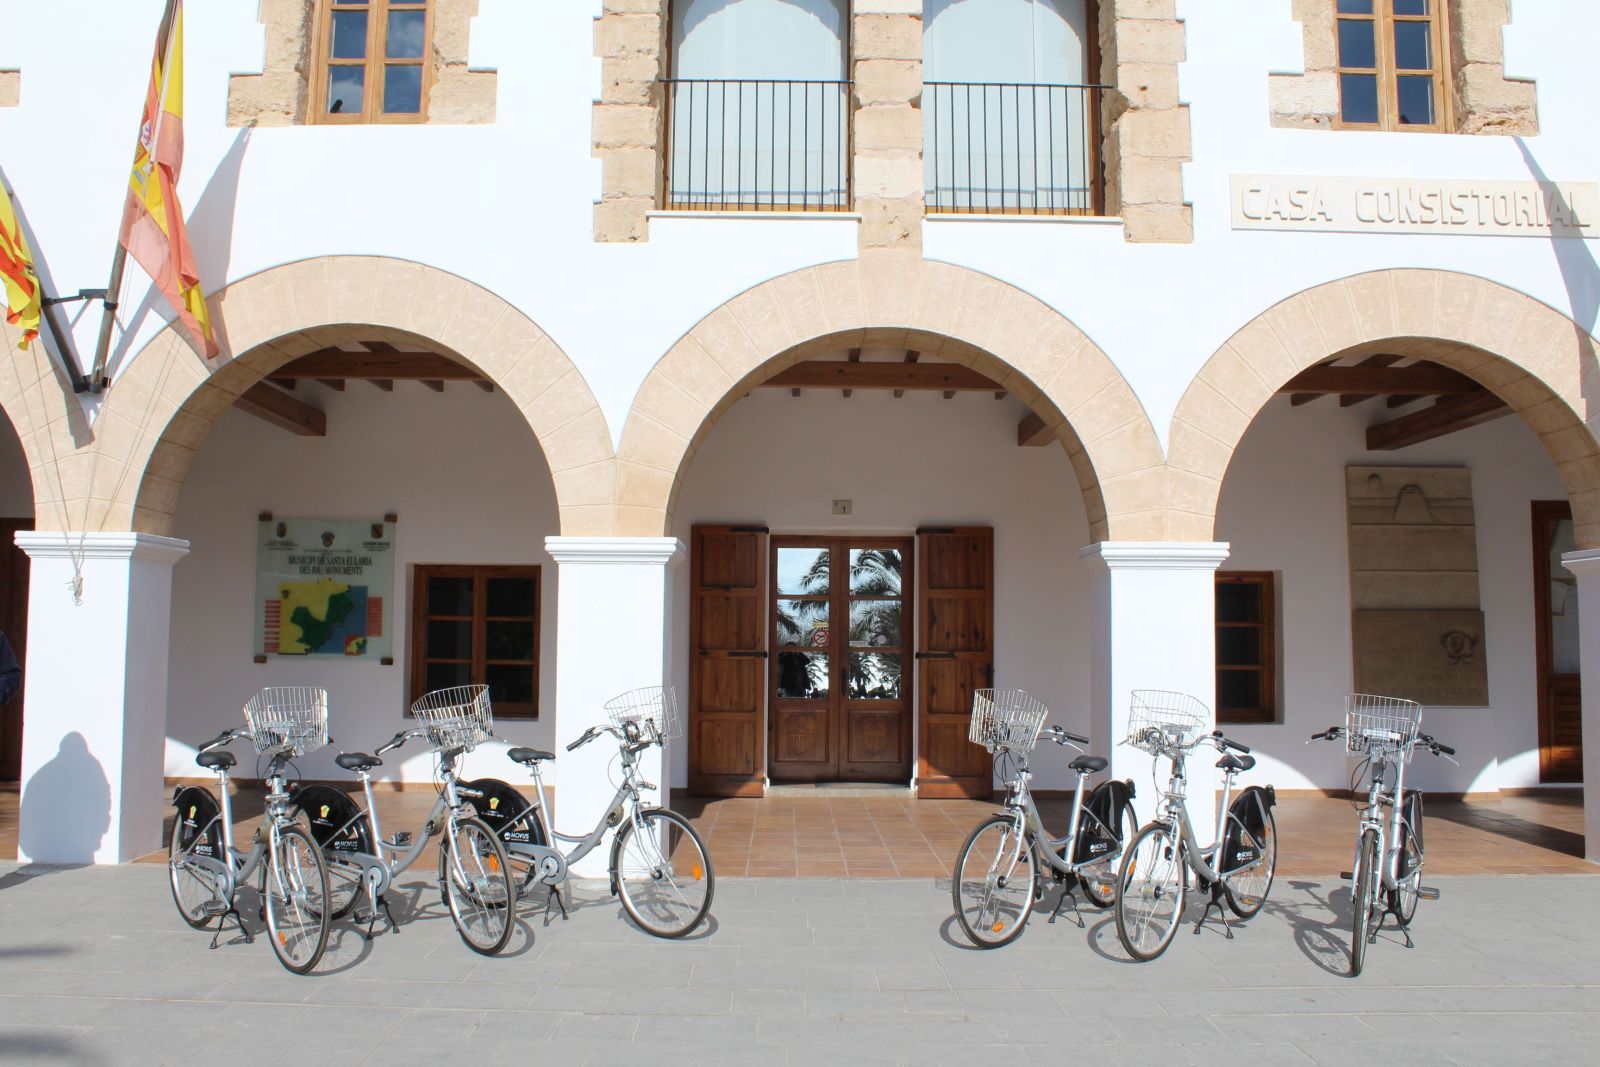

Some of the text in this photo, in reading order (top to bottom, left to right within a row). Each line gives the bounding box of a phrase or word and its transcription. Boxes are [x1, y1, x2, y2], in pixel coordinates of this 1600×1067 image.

[1241, 183, 1592, 228] CASA CONSISTORIAL
[327, 556, 345, 566] SANTA
[510, 831, 530, 839] MOVUS
[340, 840, 358, 848] MOVUS
